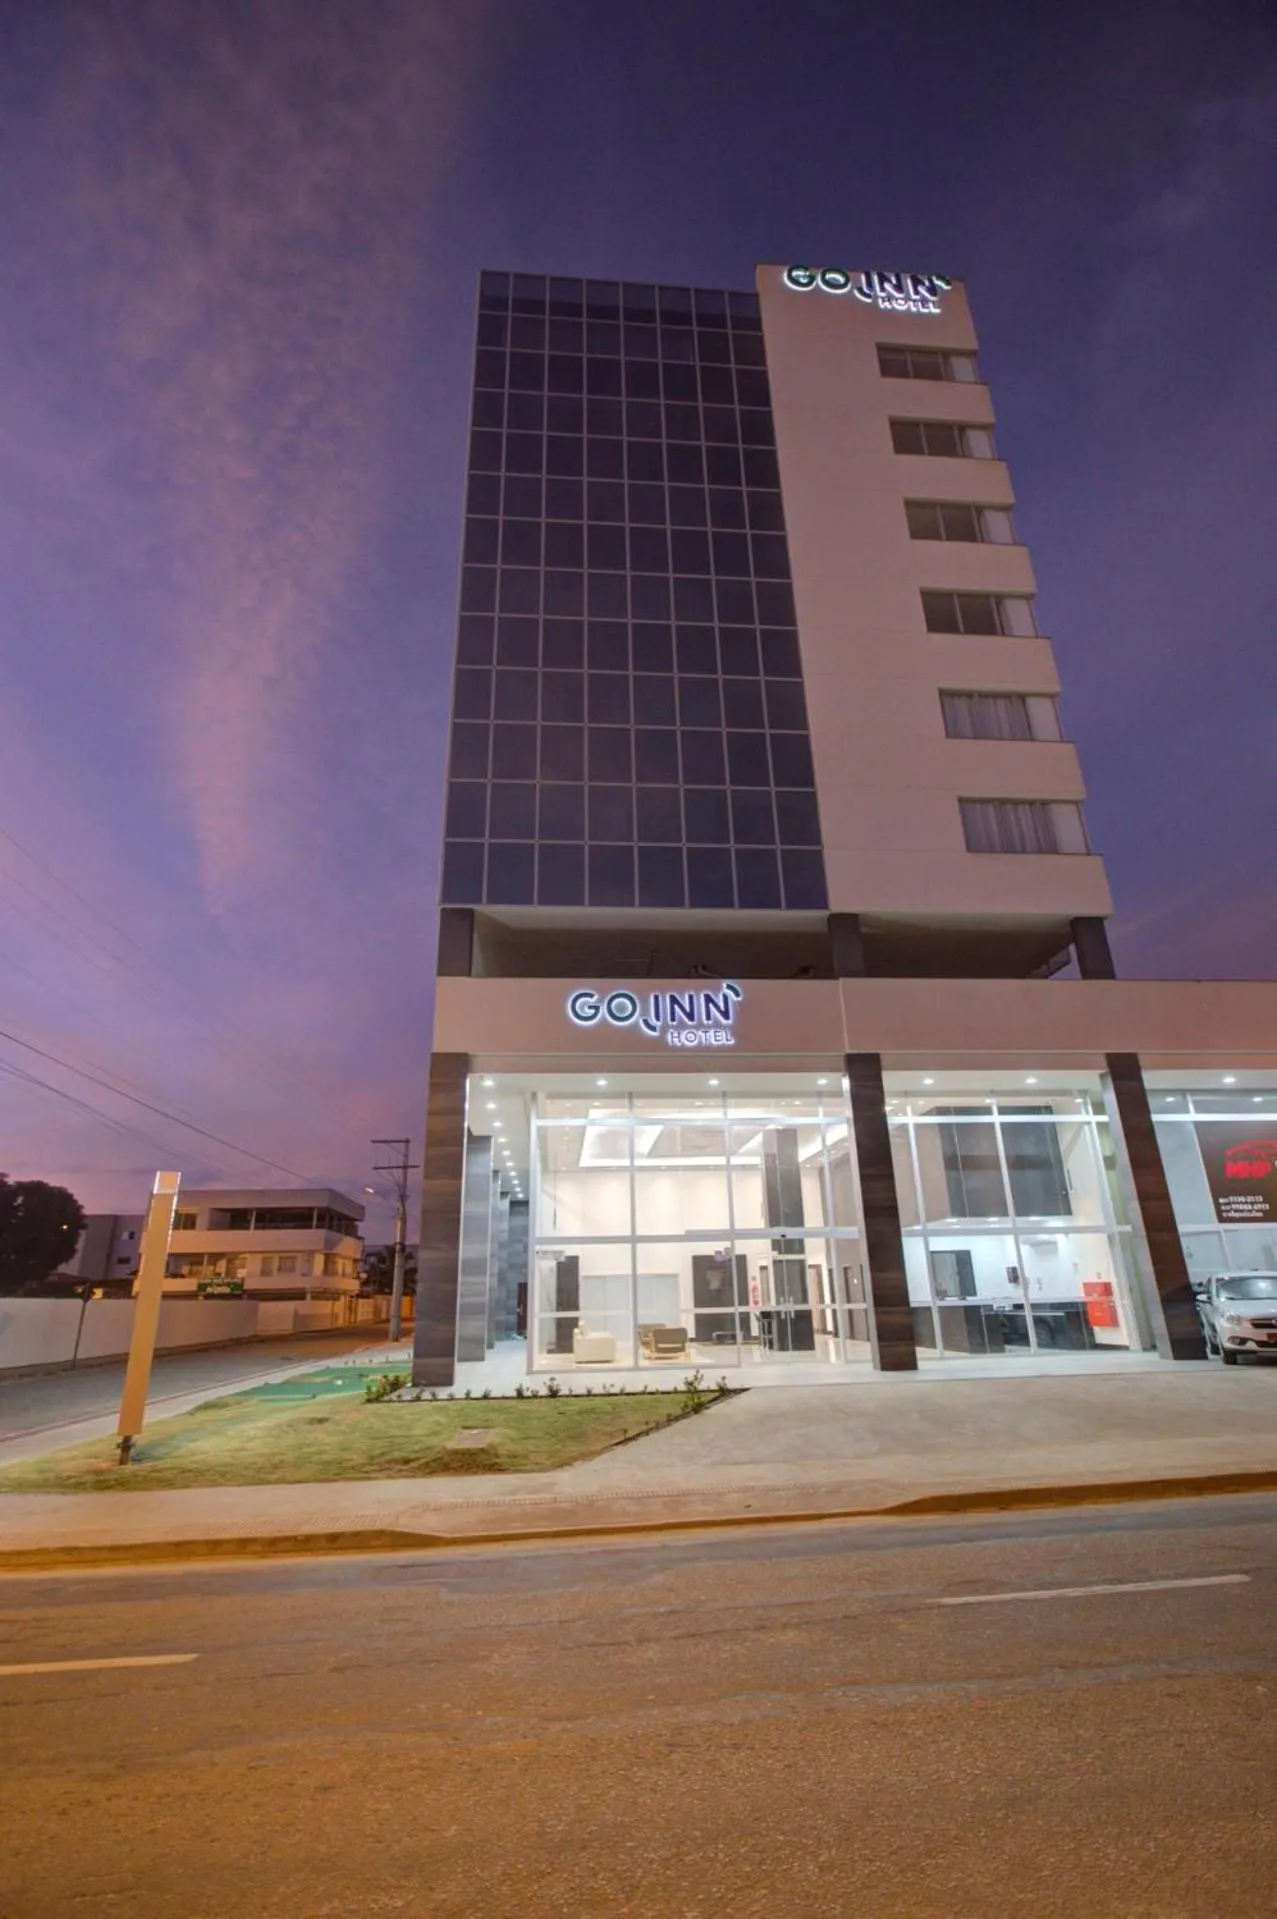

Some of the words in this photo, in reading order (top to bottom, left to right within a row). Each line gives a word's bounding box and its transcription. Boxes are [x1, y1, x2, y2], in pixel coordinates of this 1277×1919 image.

[784, 265, 851, 293] GO
[569, 991, 638, 1024] GO
[668, 1030, 735, 1046] HOTEL
